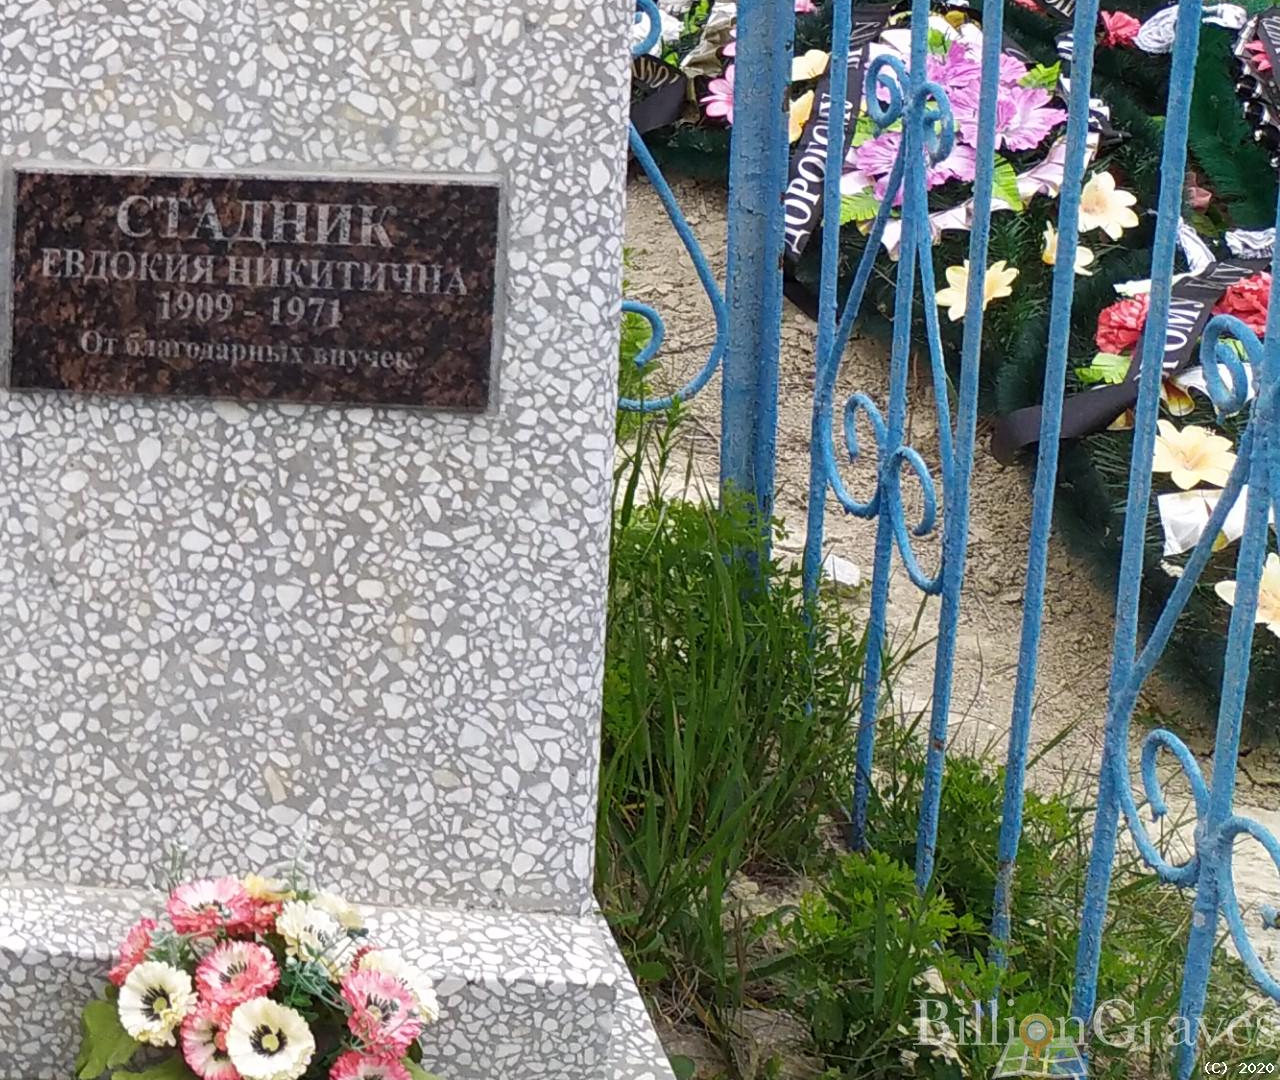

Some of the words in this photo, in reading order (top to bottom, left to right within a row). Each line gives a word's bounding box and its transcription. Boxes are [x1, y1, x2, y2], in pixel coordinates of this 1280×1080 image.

[116, 195, 396, 254] СТАДНИК
[41, 247, 215, 284] ЕВДОКИЯ
[227, 255, 469, 297] НИКИТИЧНА
[80, 330, 119, 356] От
[125, 331, 305, 368] благодарных
